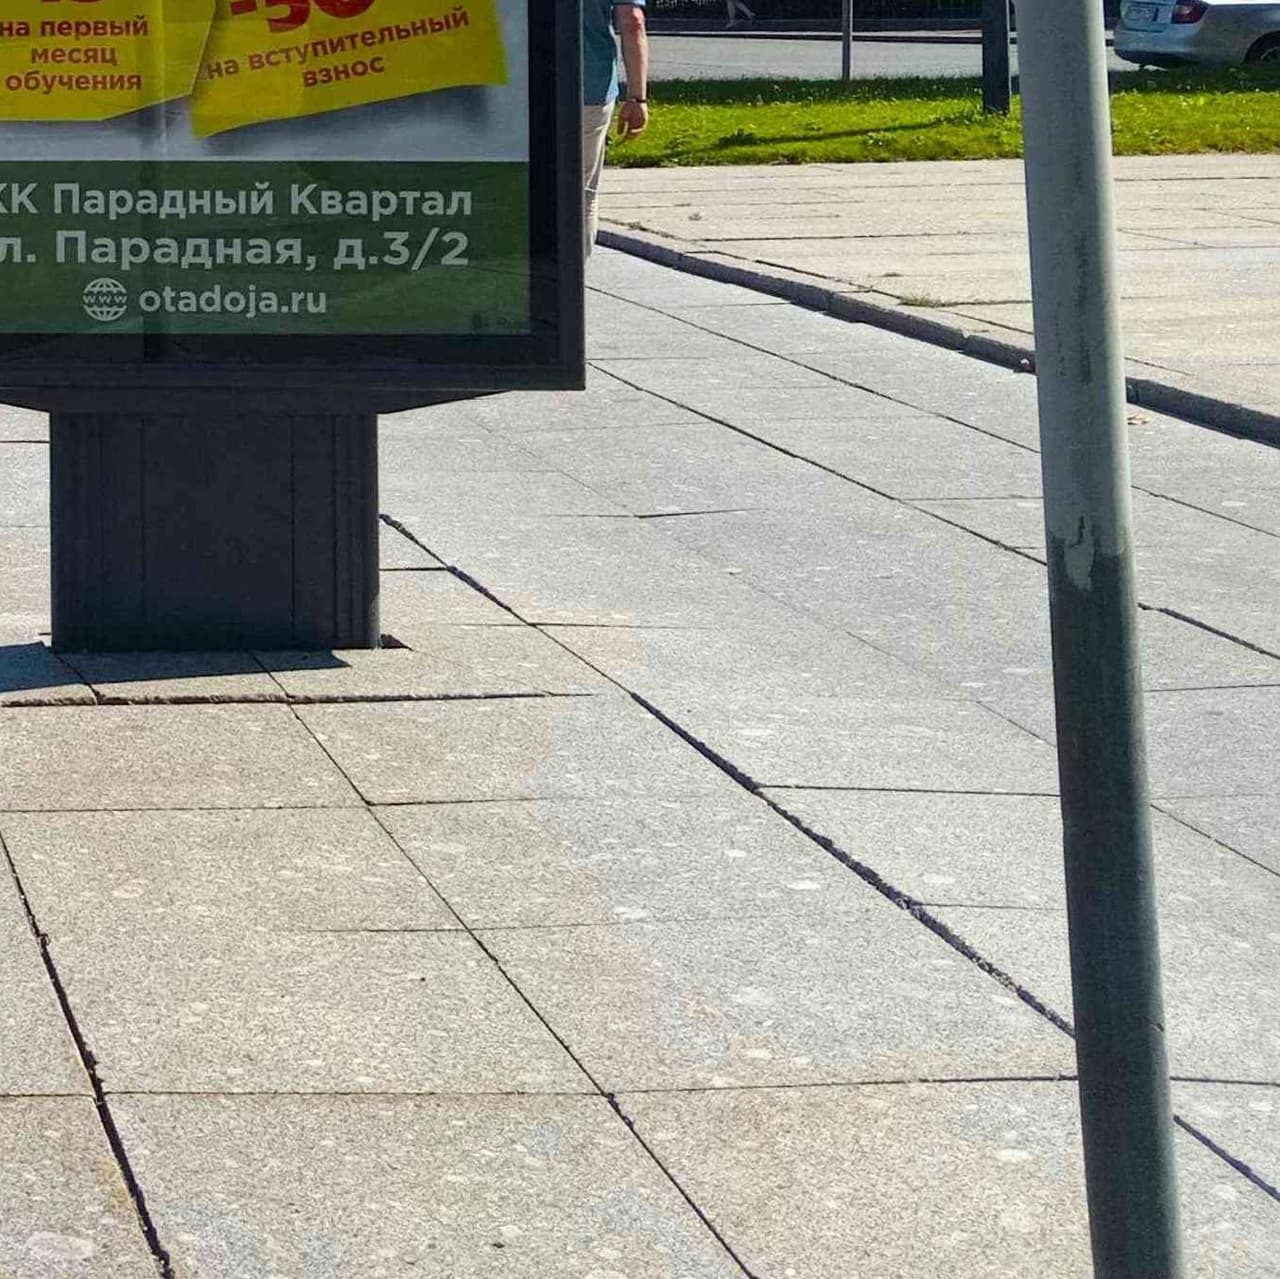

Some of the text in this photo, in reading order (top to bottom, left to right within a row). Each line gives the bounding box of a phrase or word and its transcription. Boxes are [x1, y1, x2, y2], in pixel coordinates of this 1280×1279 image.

[40, 14, 149, 41] первый
[206, 5, 471, 80] на вступительный
[31, 46, 118, 66] месяц
[302, 56, 386, 88] взнос
[5, 70, 142, 95] обучения
[53, 181, 274, 221] Парадный
[290, 183, 473, 222] Квартал
[54, 230, 317, 271] Парадная,
[333, 226, 470, 271] д.3/2
[139, 284, 327, 319] otadoja.ru
